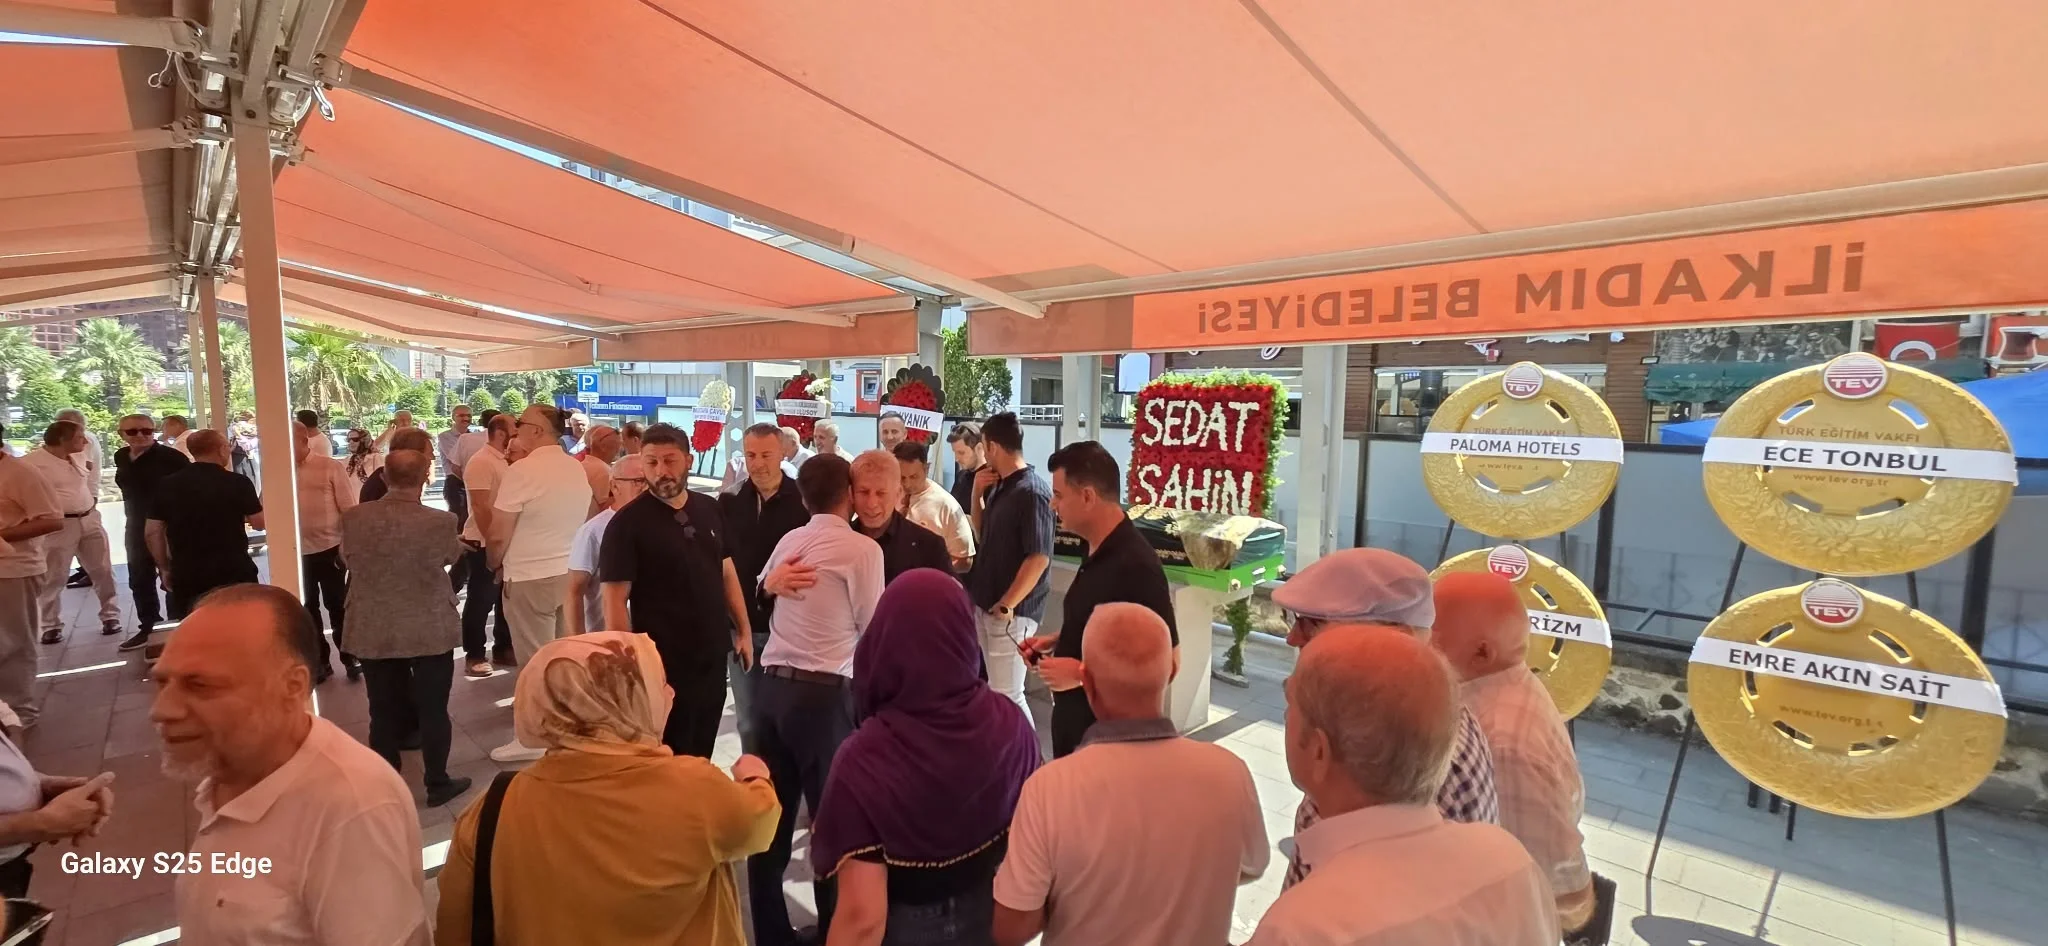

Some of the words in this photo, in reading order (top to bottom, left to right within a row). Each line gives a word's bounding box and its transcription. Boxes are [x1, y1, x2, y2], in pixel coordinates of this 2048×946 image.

[582, 375, 594, 390] P
[1507, 383, 1539, 393] TEV
[1830, 378, 1880, 389] TEV
[1141, 398, 1260, 452] SEDAT
[1779, 425, 1815, 437] TÜRK
[1820, 427, 1869, 440] EĞİTİM
[1875, 431, 1920, 443] VAKFI
[1450, 438, 1512, 453] PALOMA
[1517, 441, 1581, 456] HOTELS
[1763, 446, 1813, 463] ECE
[1823, 449, 1947, 472] TONBUL
[1491, 562, 1524, 575] TEV
[1809, 605, 1857, 618] TEV
[1728, 648, 1796, 674] EMRE
[1803, 661, 1871, 687] AKIN
[1880, 674, 1951, 700] SAİT
